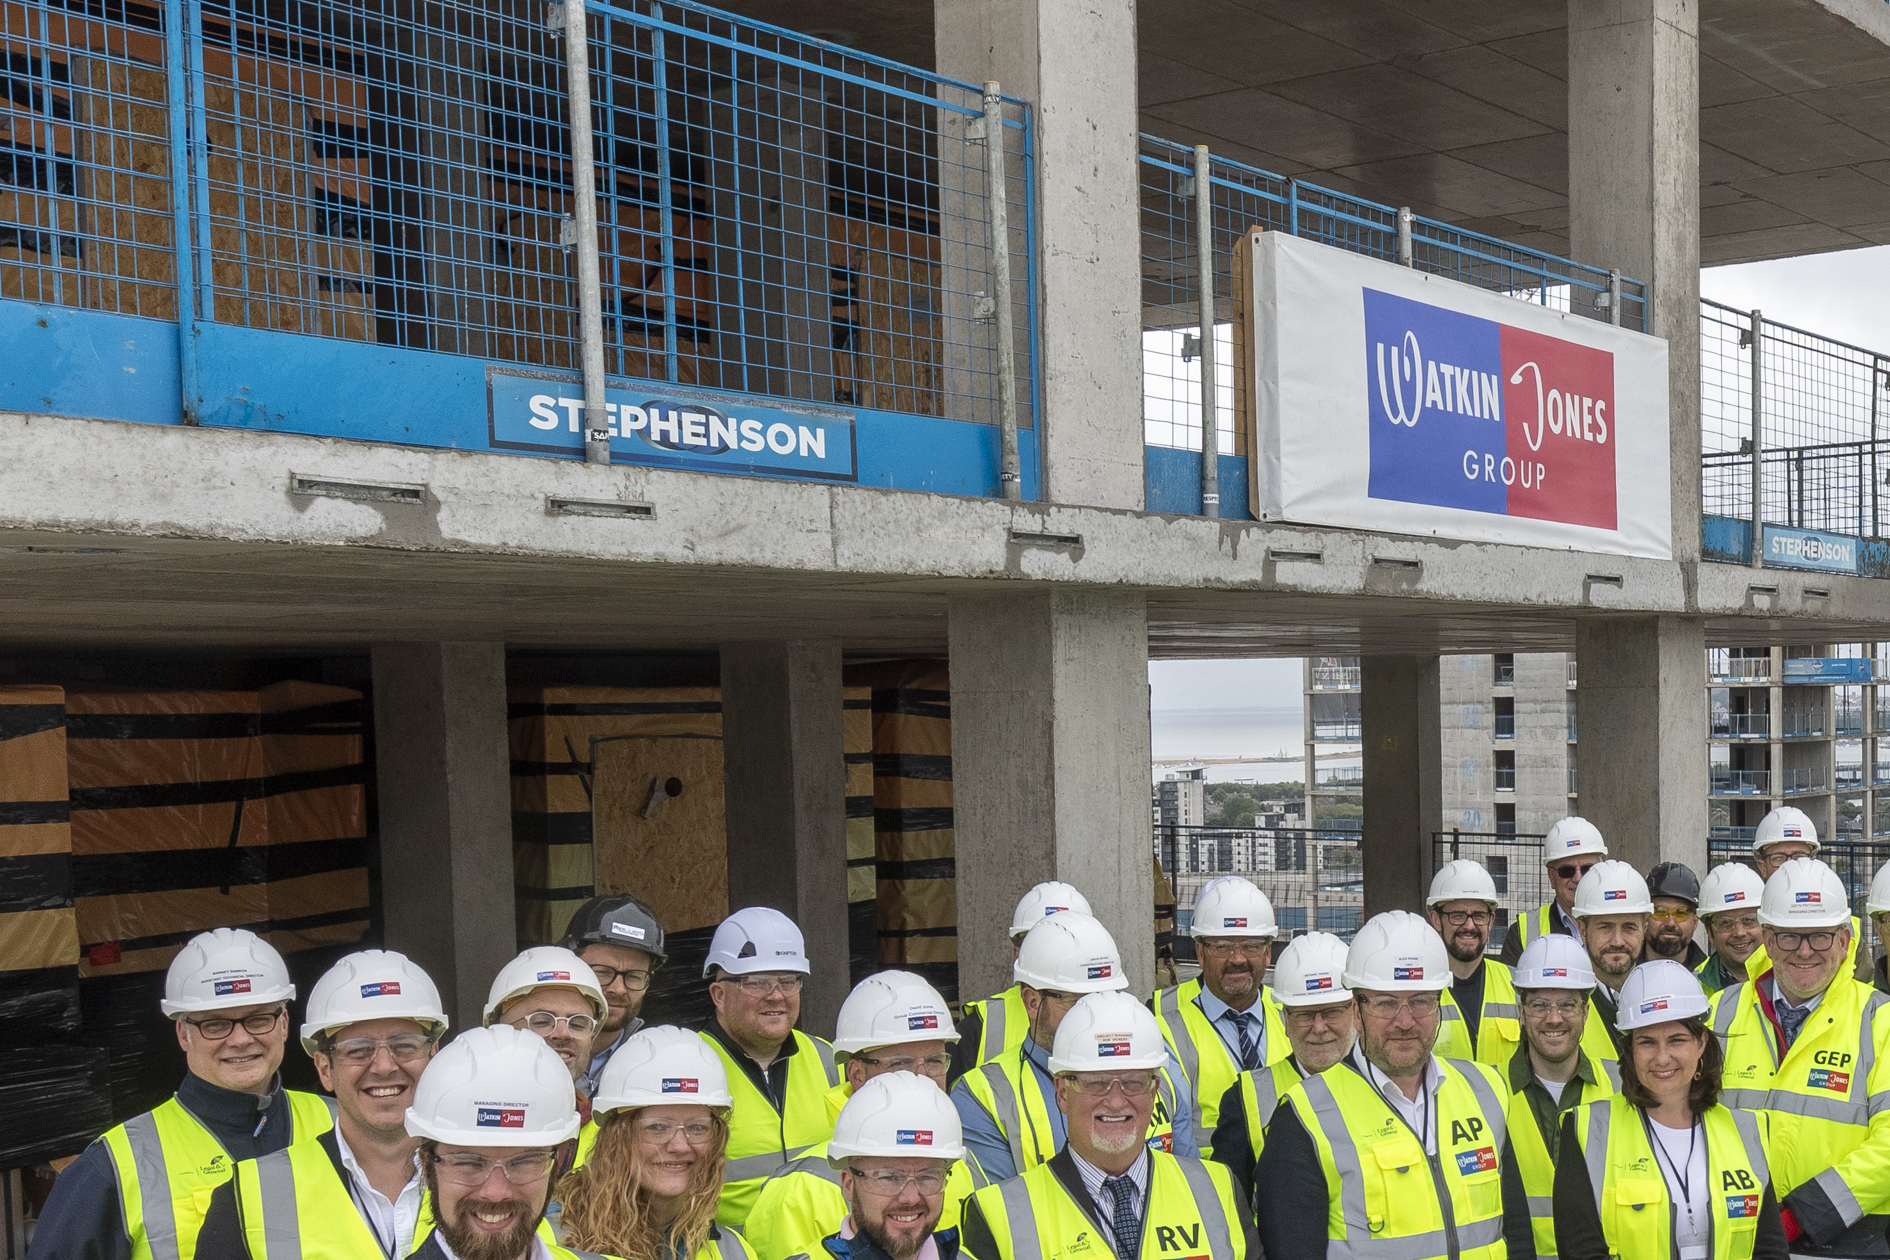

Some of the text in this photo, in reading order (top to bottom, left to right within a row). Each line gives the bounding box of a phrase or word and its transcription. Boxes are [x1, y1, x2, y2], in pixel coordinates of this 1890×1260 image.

[1377, 330, 1608, 451] WATKIN JONES
[529, 395, 825, 459] STEPHENSON
[1463, 450, 1546, 490] GROUP
[1771, 535, 1850, 562] STEPHENSON
[1464, 810, 1481, 829] 20
[1813, 1050, 1851, 1068] GEP
[1809, 1070, 1848, 1084] WATKIN JONES
[1451, 1117, 1483, 1146] AP
[200, 1164, 216, 1172] Legal
[1457, 1151, 1495, 1168] WATKIN JONES
[1471, 1162, 1487, 1171] GROUP
[1722, 1169, 1755, 1192] AB
[1155, 1222, 1200, 1252] RV
